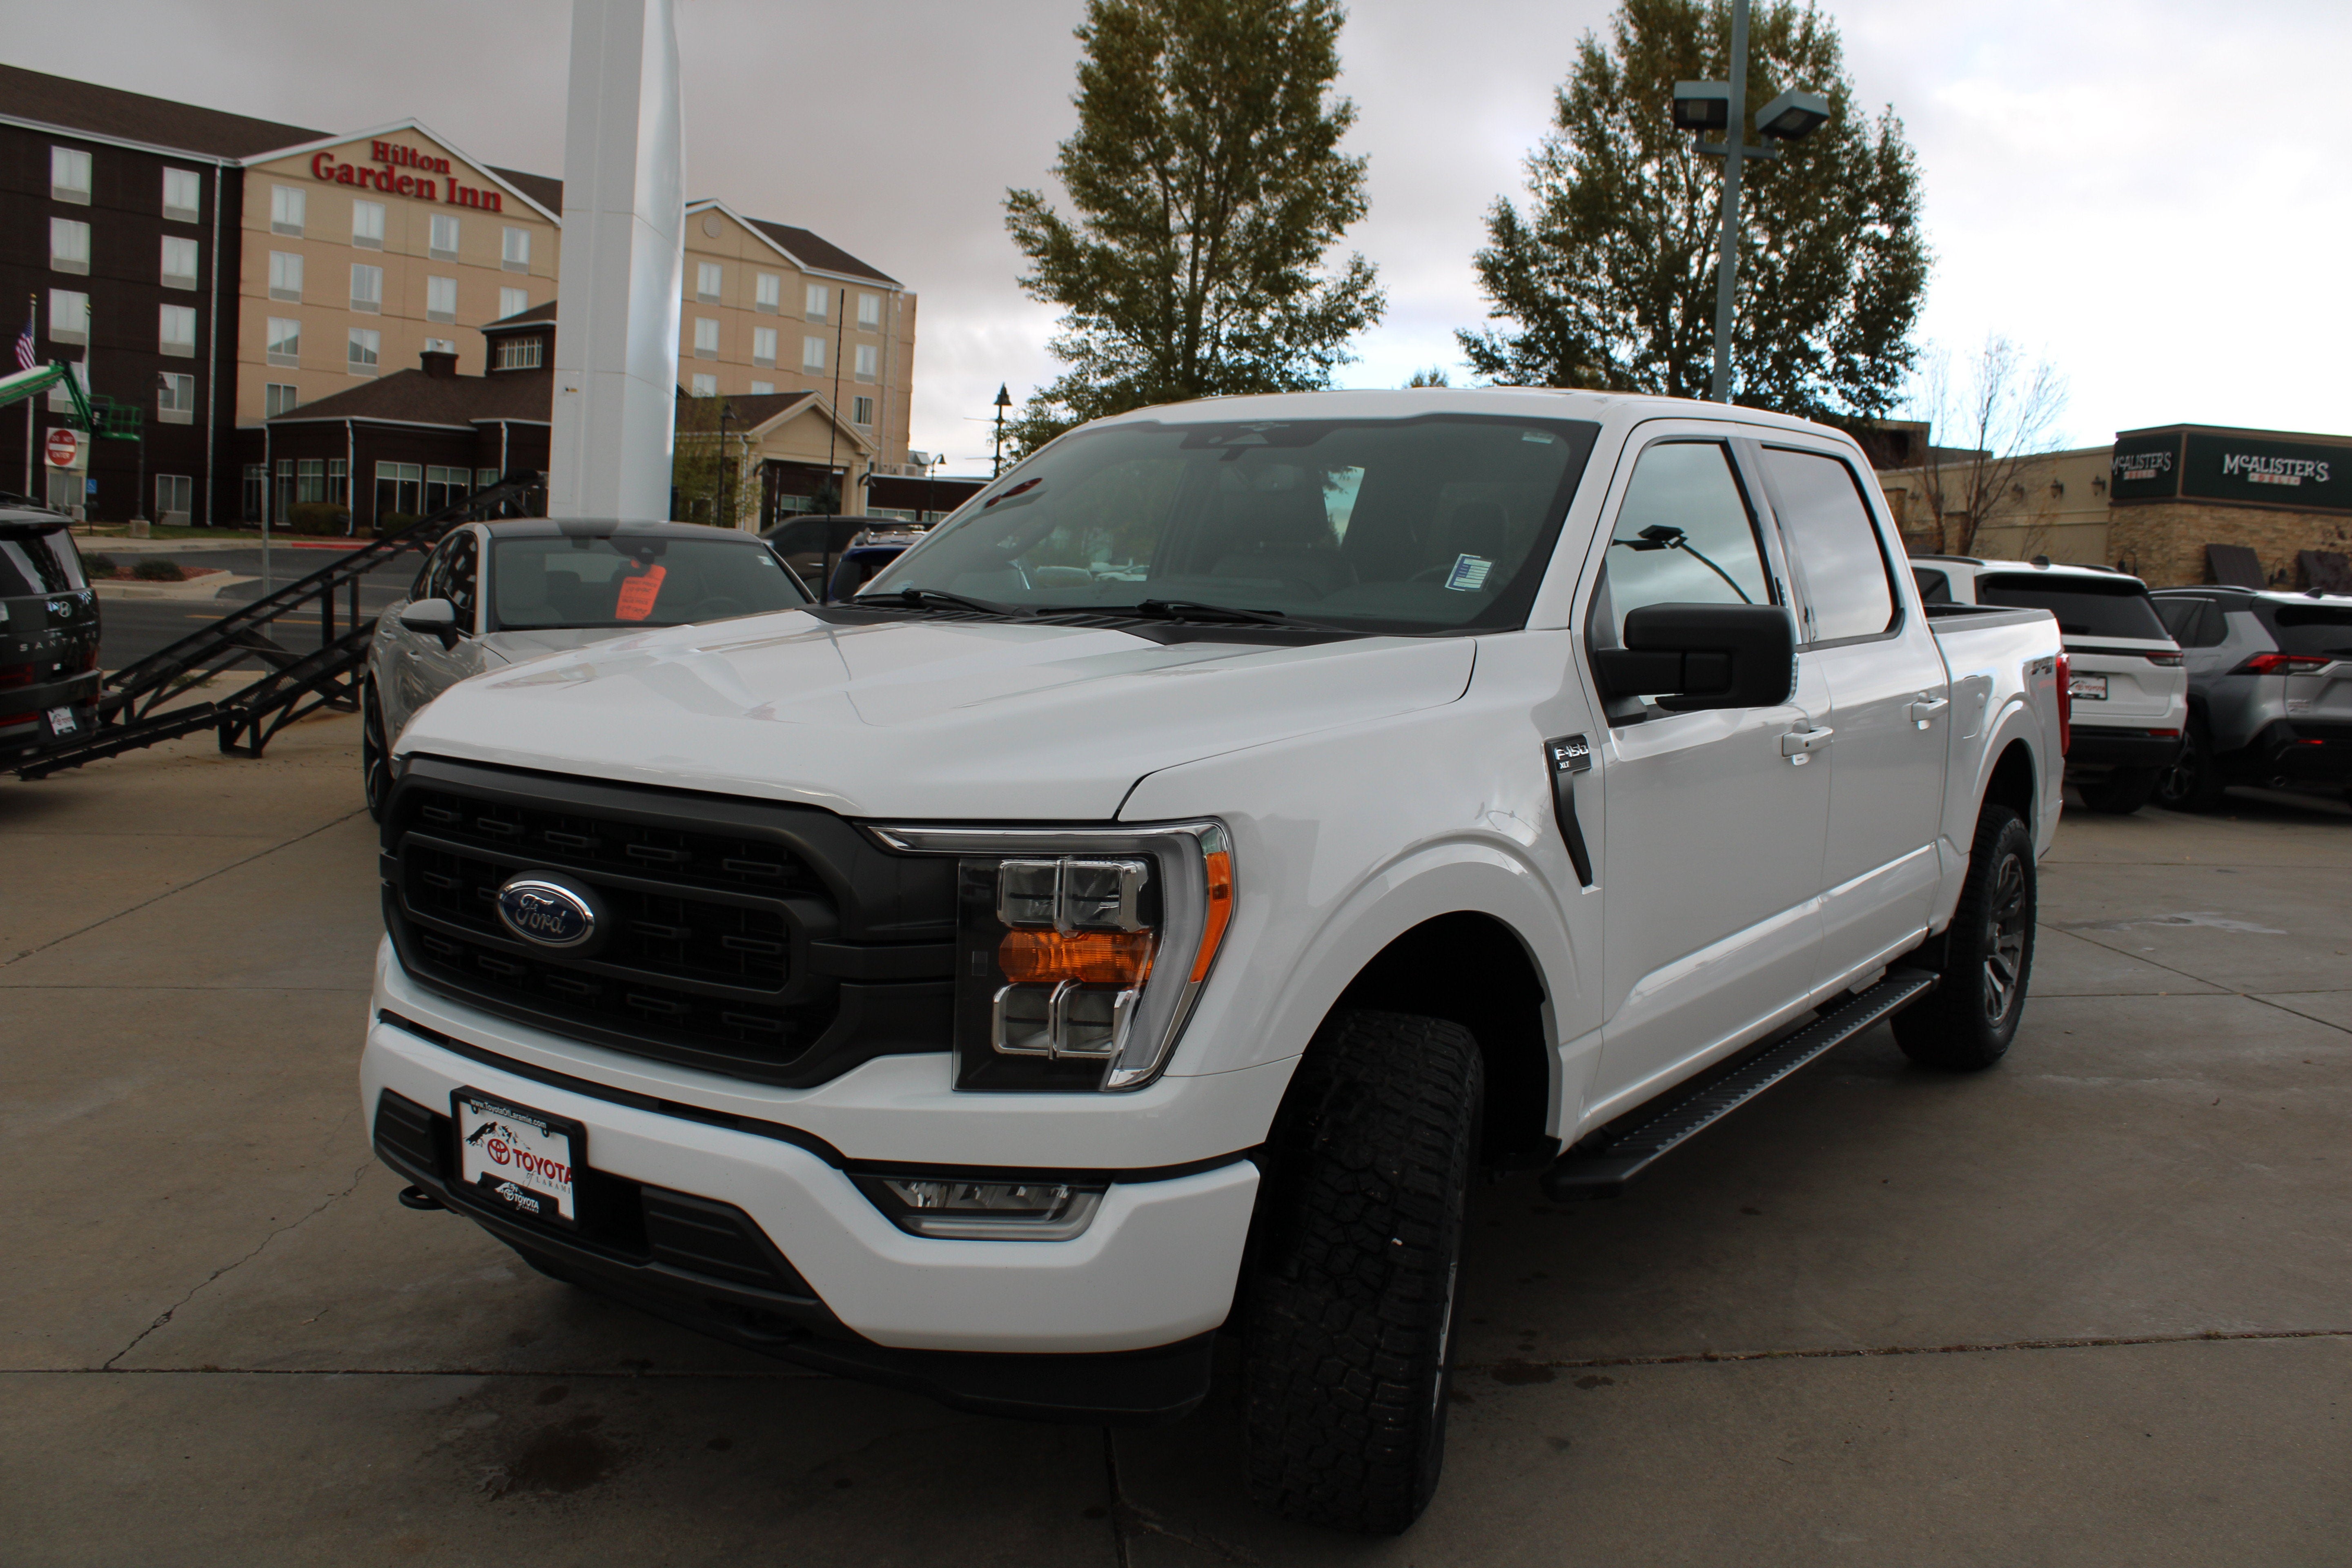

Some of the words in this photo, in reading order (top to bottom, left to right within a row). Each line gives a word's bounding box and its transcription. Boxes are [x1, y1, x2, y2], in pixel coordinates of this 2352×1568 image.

[372, 140, 450, 174] Hilton
[312, 152, 437, 200] Garden
[447, 177, 502, 212] Inn
[19, 636, 79, 652] SANTA
[85, 630, 97, 639] FE
[1554, 743, 1590, 760] F-150
[1559, 761, 1570, 769] XLT
[514, 893, 567, 934] Ford
[470, 1098, 547, 1129] www.ToyotaOfLaramie.com
[512, 1148, 572, 1185] TOYOTA
[536, 1176, 571, 1194] LARAMI
[514, 1193, 539, 1209] TOYOTA
